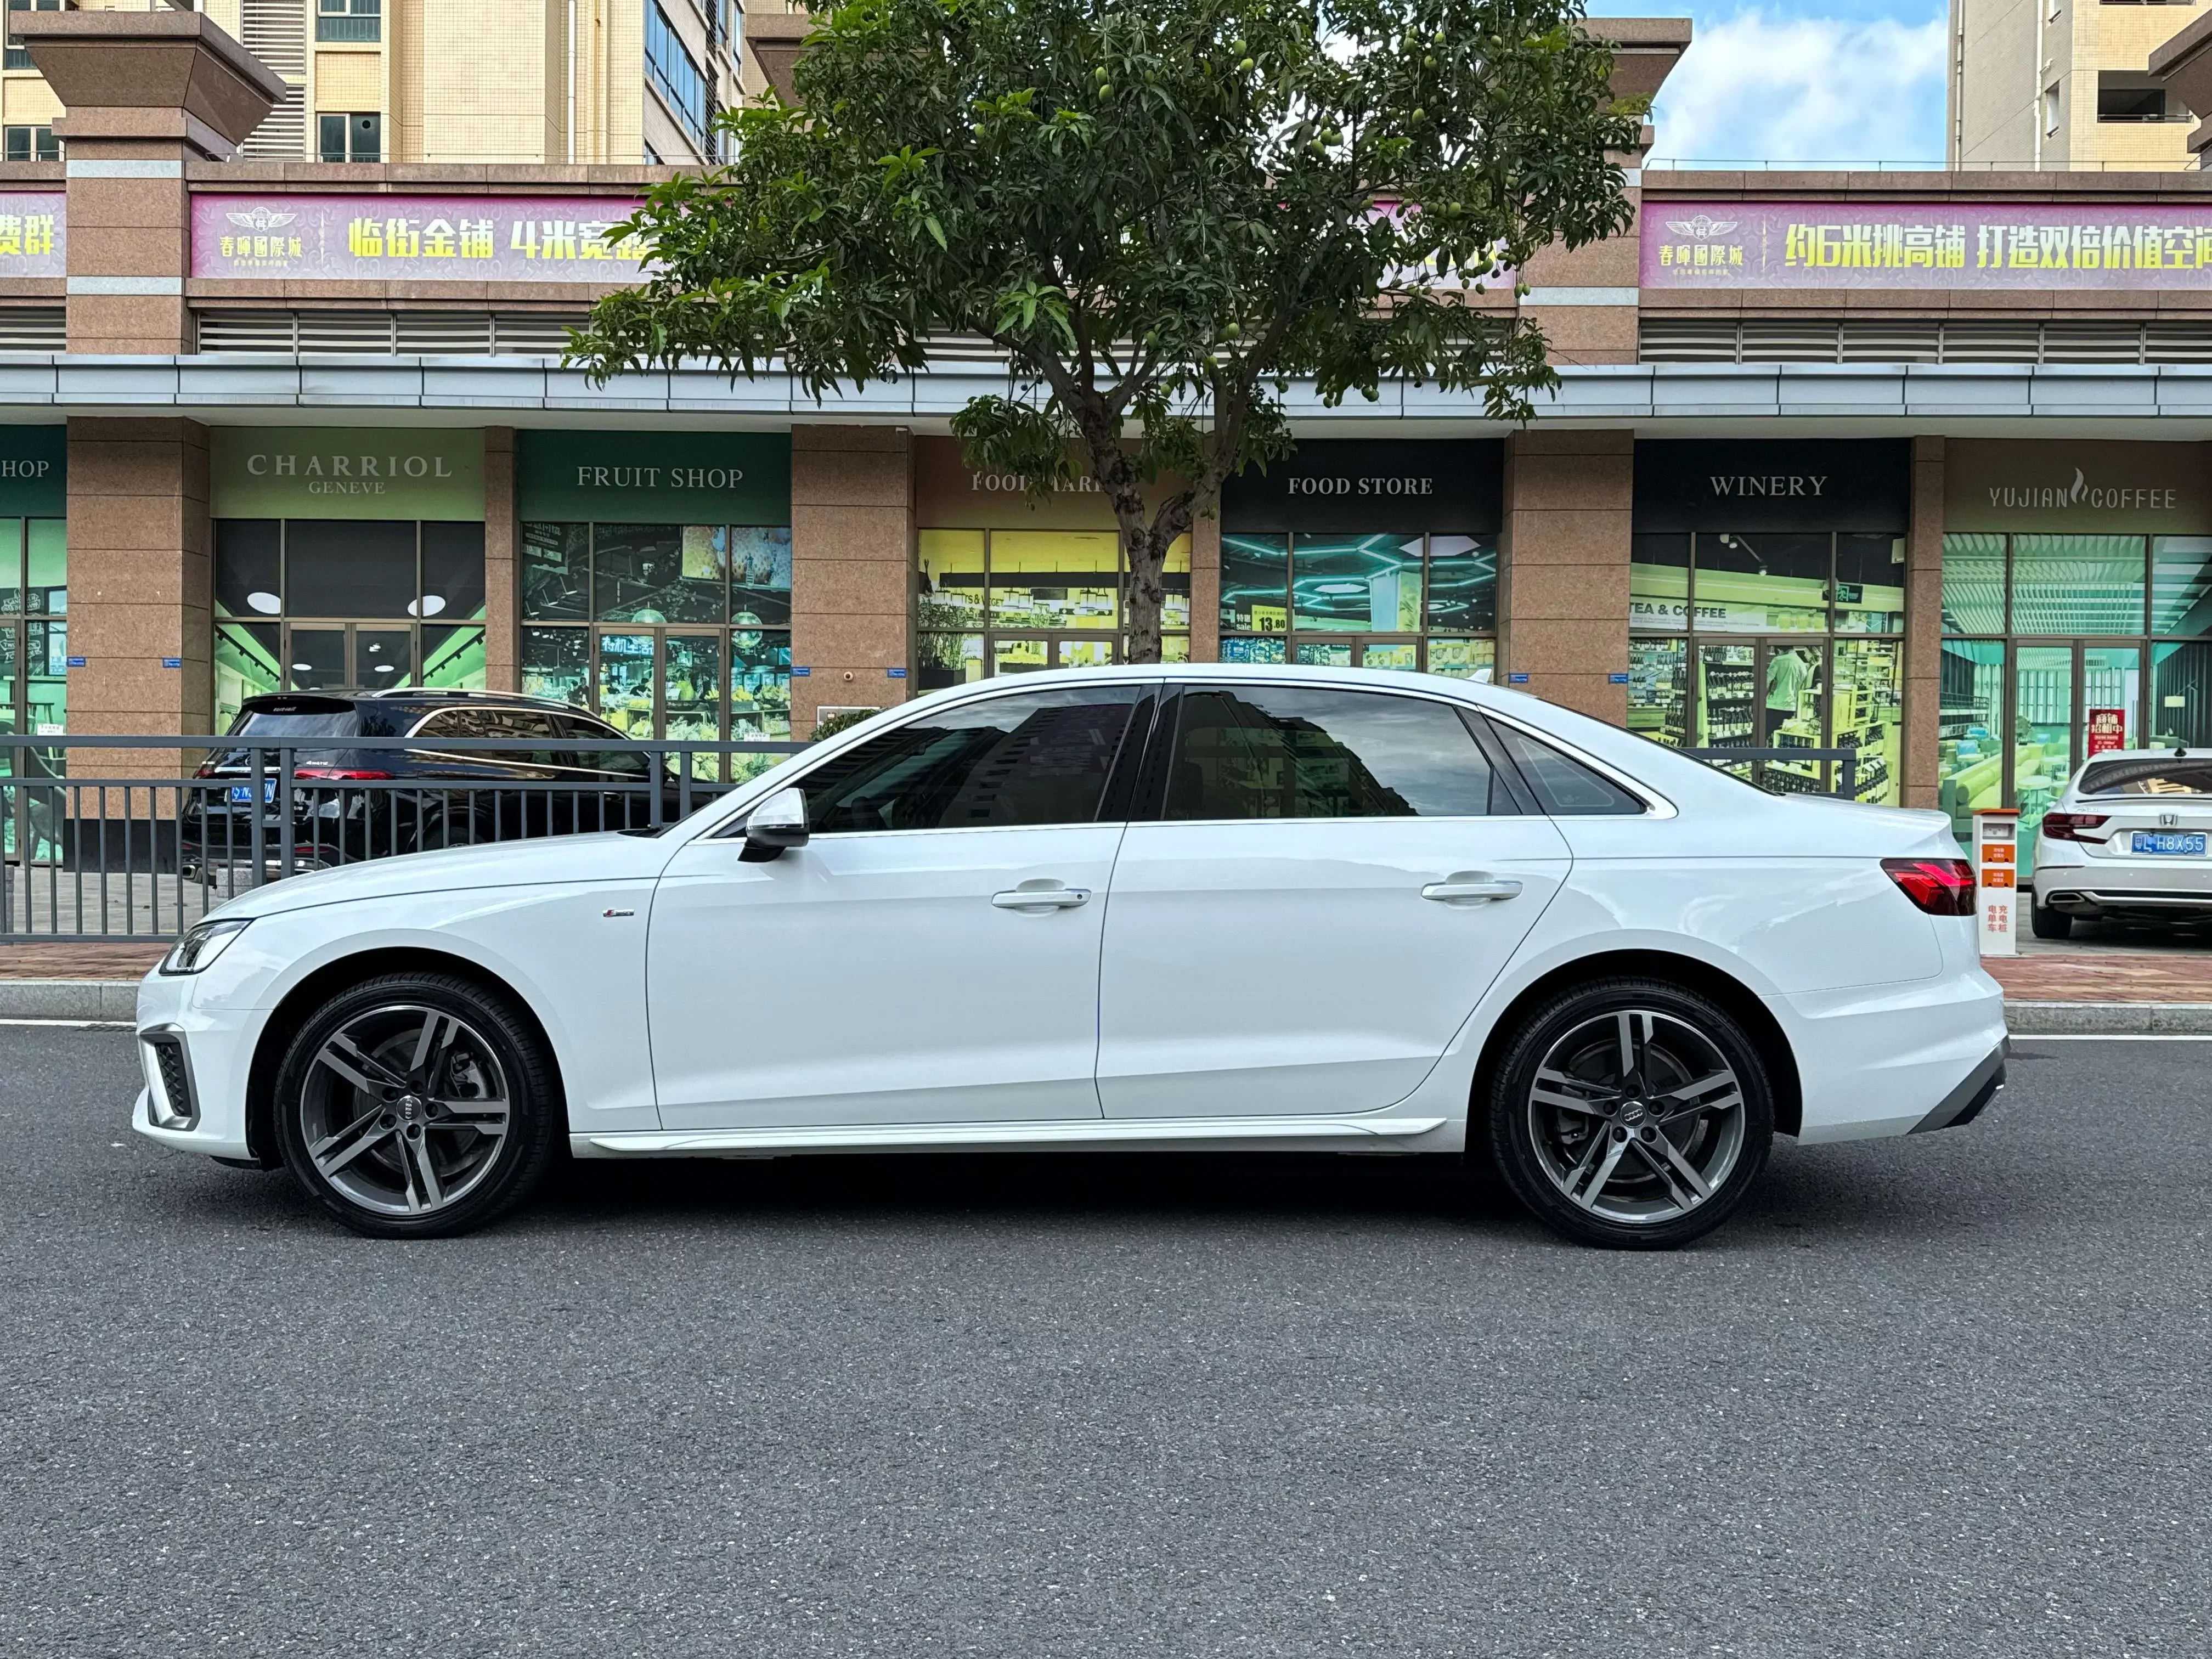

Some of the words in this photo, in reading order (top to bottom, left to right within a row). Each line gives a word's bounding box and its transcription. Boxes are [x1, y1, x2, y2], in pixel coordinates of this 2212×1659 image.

[348, 218, 493, 258] 临街金铺
[1785, 224, 1965, 268] 约6米挑高铺
[247, 454, 452, 477] CHARRIOL
[308, 481, 386, 494] GENEVE
[577, 467, 660, 487] FRUIT
[671, 468, 743, 488] SHOP
[1288, 478, 1350, 494] FOOD
[1358, 478, 1432, 494] STORE
[1709, 476, 1828, 496] WINERY
[1989, 487, 2068, 507] YUJIAN
[2091, 488, 2177, 509] COFFEE
[1658, 604, 1668, 615] &
[1236, 622, 1251, 630] sale
